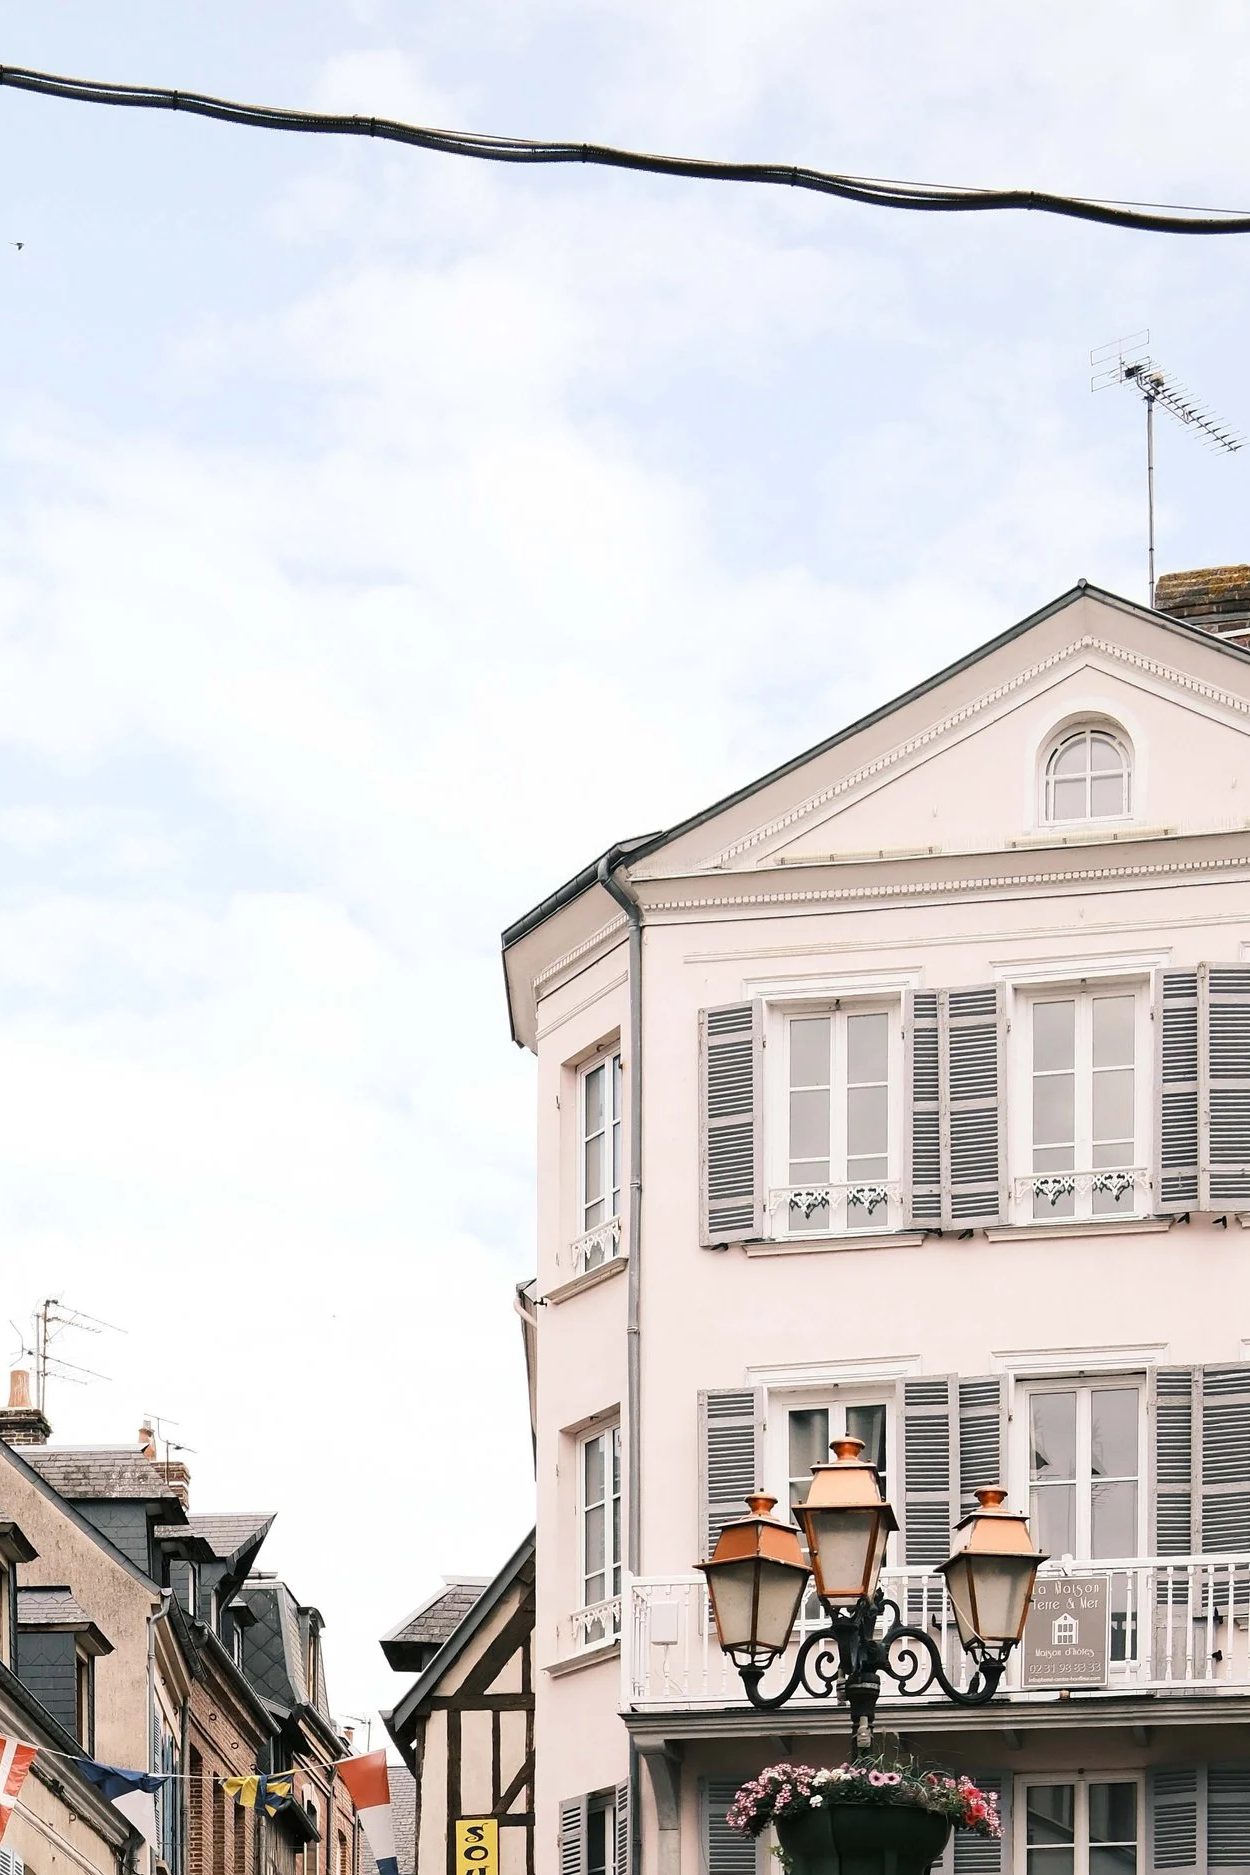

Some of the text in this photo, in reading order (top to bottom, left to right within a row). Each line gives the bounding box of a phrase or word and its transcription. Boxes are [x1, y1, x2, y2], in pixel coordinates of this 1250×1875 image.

[1055, 1581, 1099, 1597] Maison
[1033, 1597, 1099, 1610] Terre & Mer
[1035, 1648, 1062, 1659] Maison
[1044, 1663, 1056, 1673] 31
